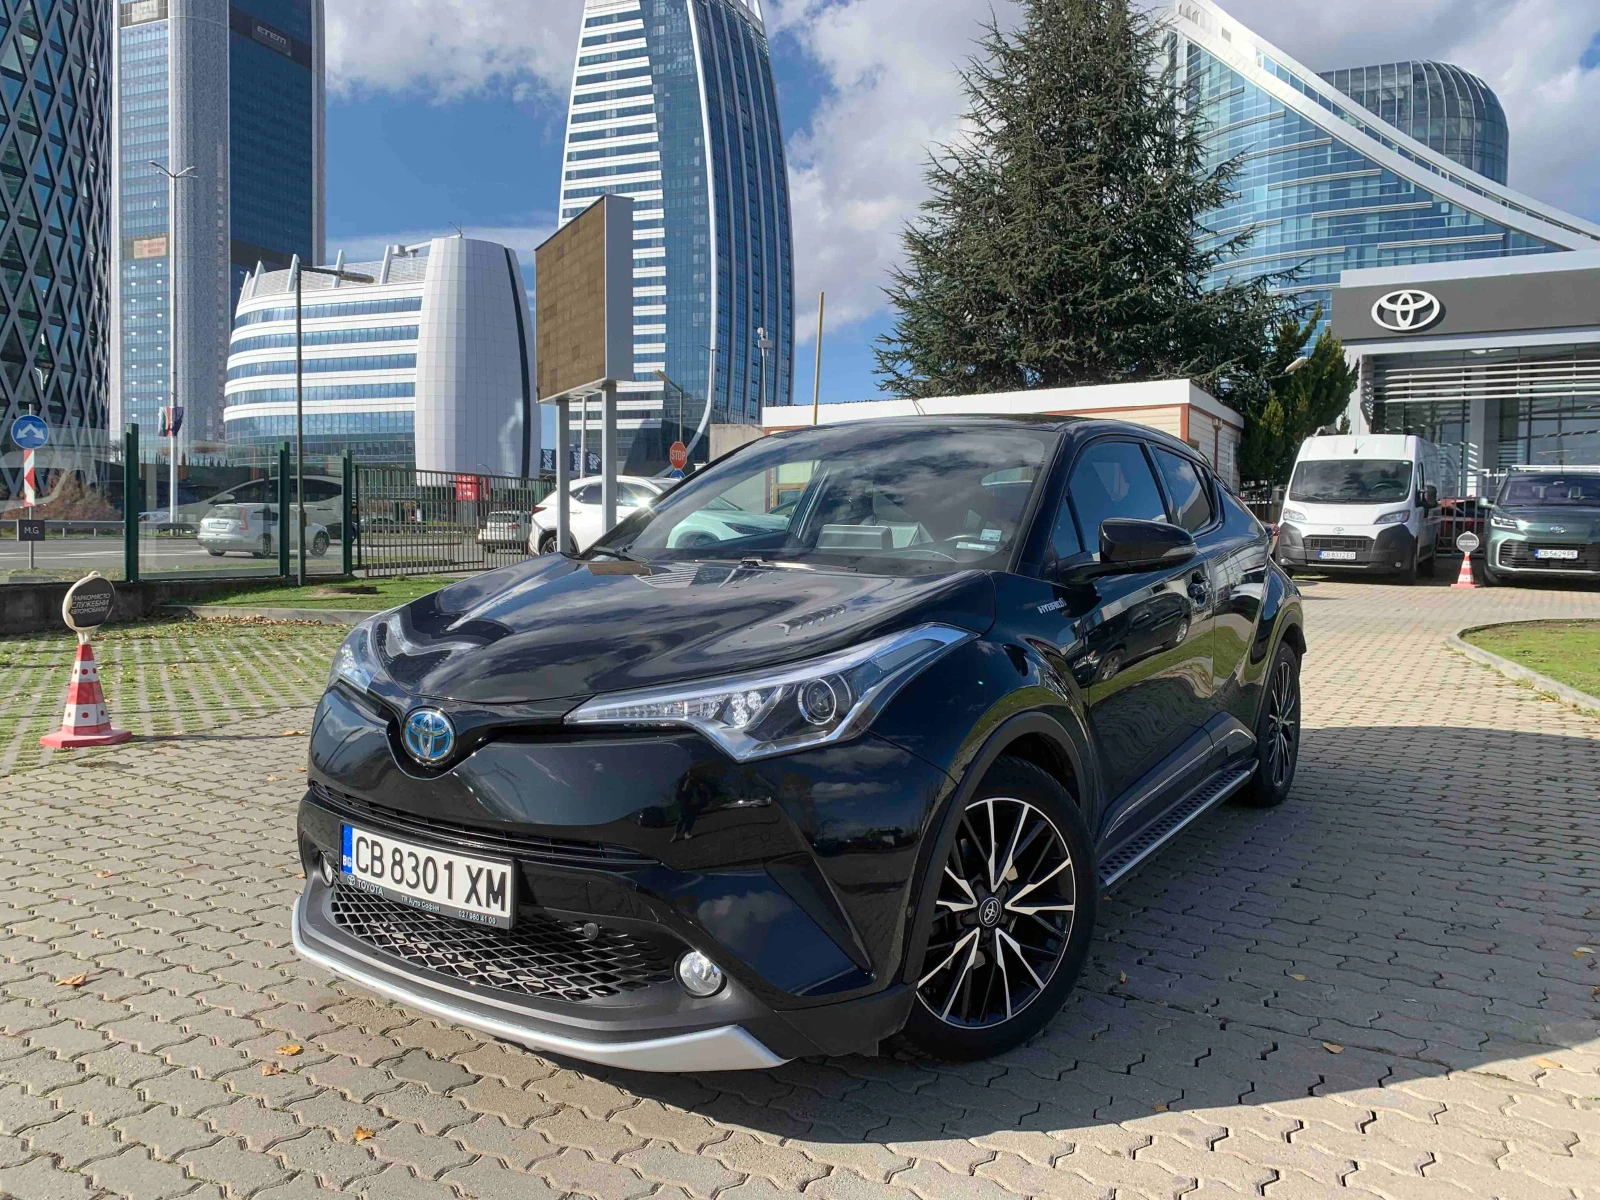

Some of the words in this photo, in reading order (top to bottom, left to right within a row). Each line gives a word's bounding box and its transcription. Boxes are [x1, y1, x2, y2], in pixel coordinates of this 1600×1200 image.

[671, 450, 686, 462] STOP
[71, 599, 110, 609] СЛУЖЕБНИ
[1037, 597, 1067, 614] HYBRID
[342, 854, 352, 868] BG
[355, 836, 385, 879] CB
[390, 847, 454, 901] 8301
[464, 864, 508, 912] XM
[357, 879, 384, 896] TOYOTA
